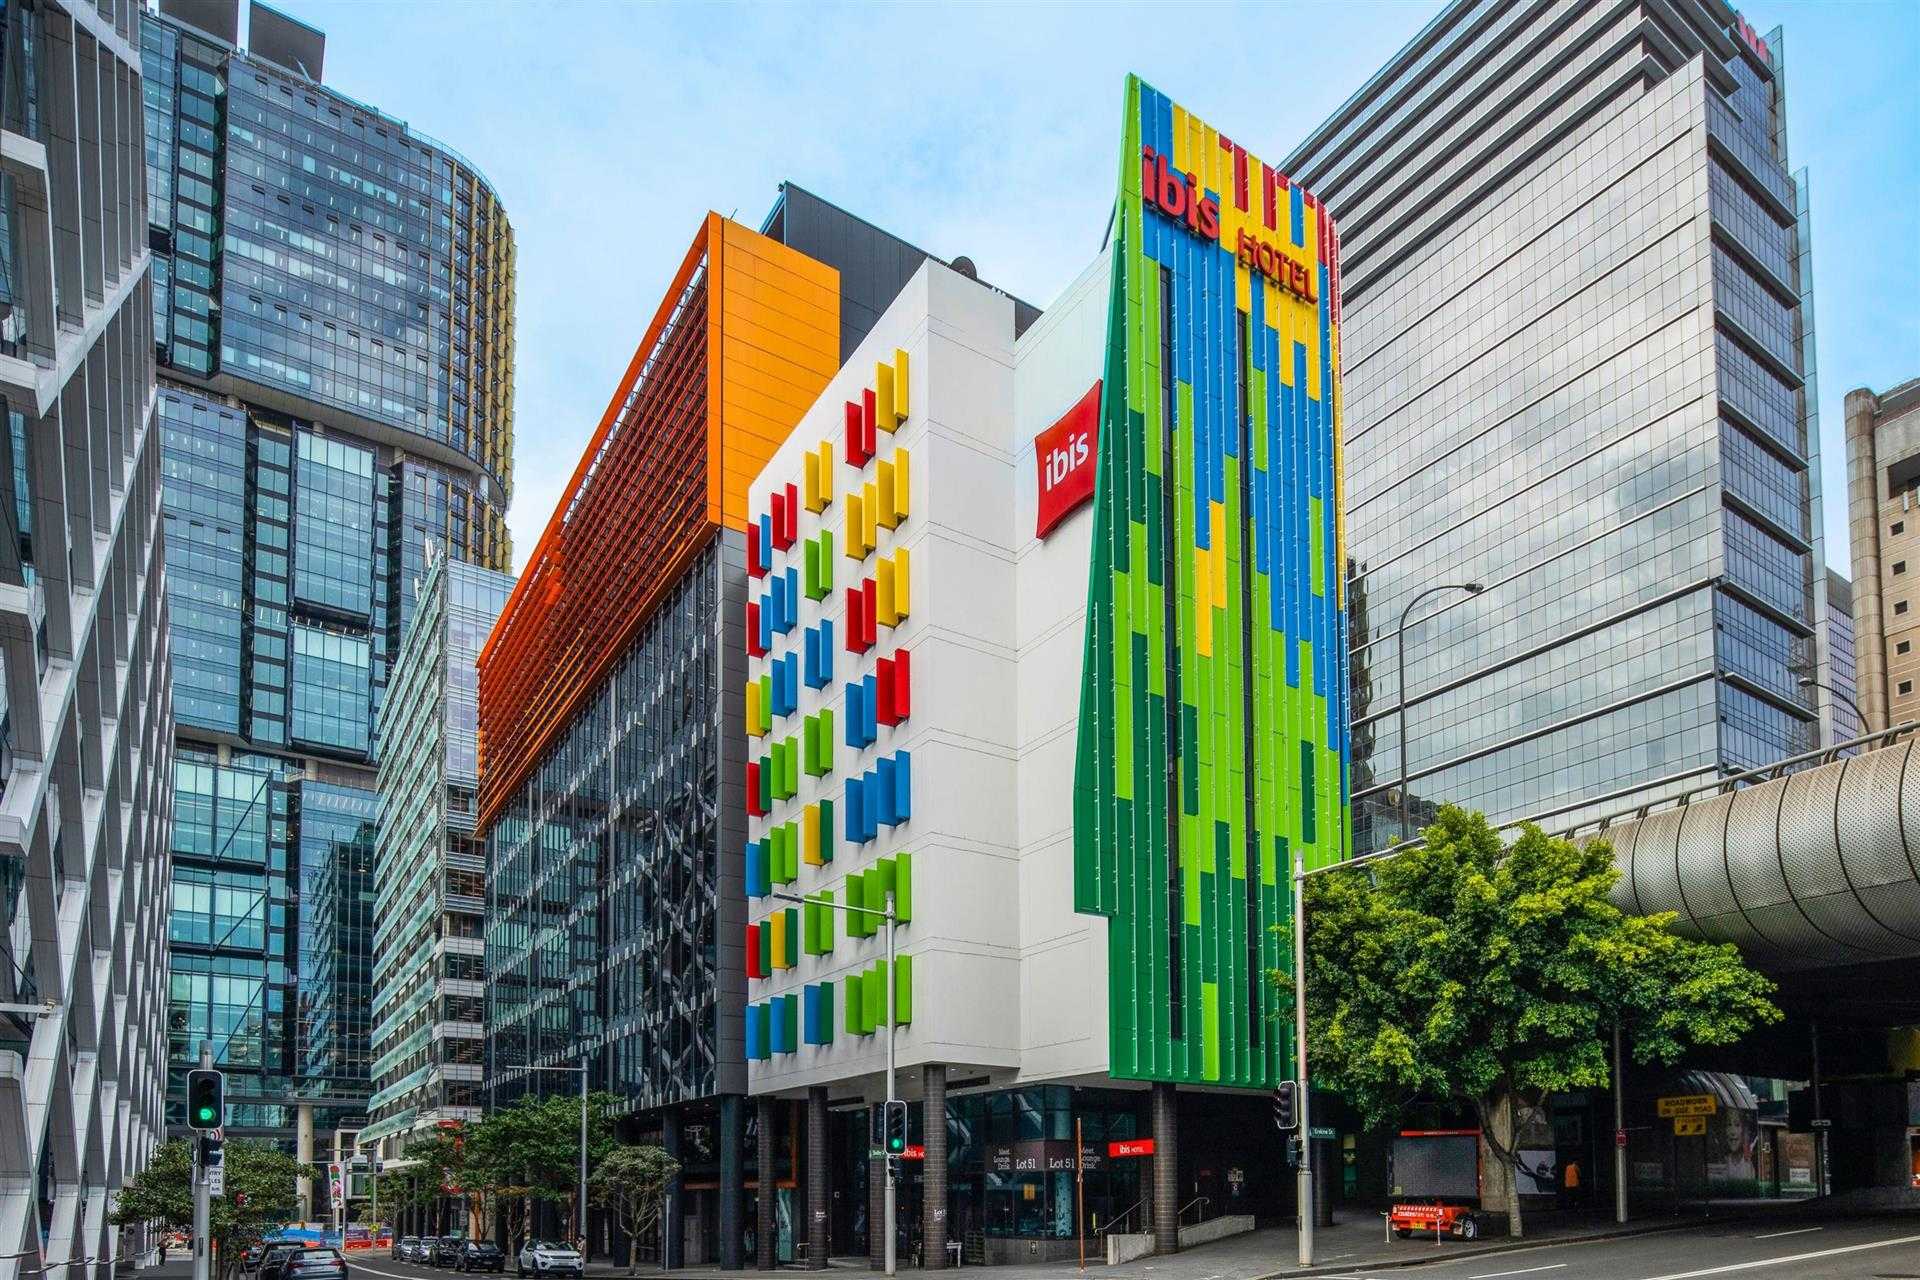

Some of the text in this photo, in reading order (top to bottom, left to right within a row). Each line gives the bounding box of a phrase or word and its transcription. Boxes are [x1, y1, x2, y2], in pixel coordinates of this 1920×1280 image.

[1141, 144, 1318, 305] ibis HOTEL
[1045, 432, 1089, 492] ibis
[1120, 1145, 1130, 1153] ibis
[1016, 1158, 1036, 1170] Lot 51
[1049, 1158, 1075, 1169] Lot 51
